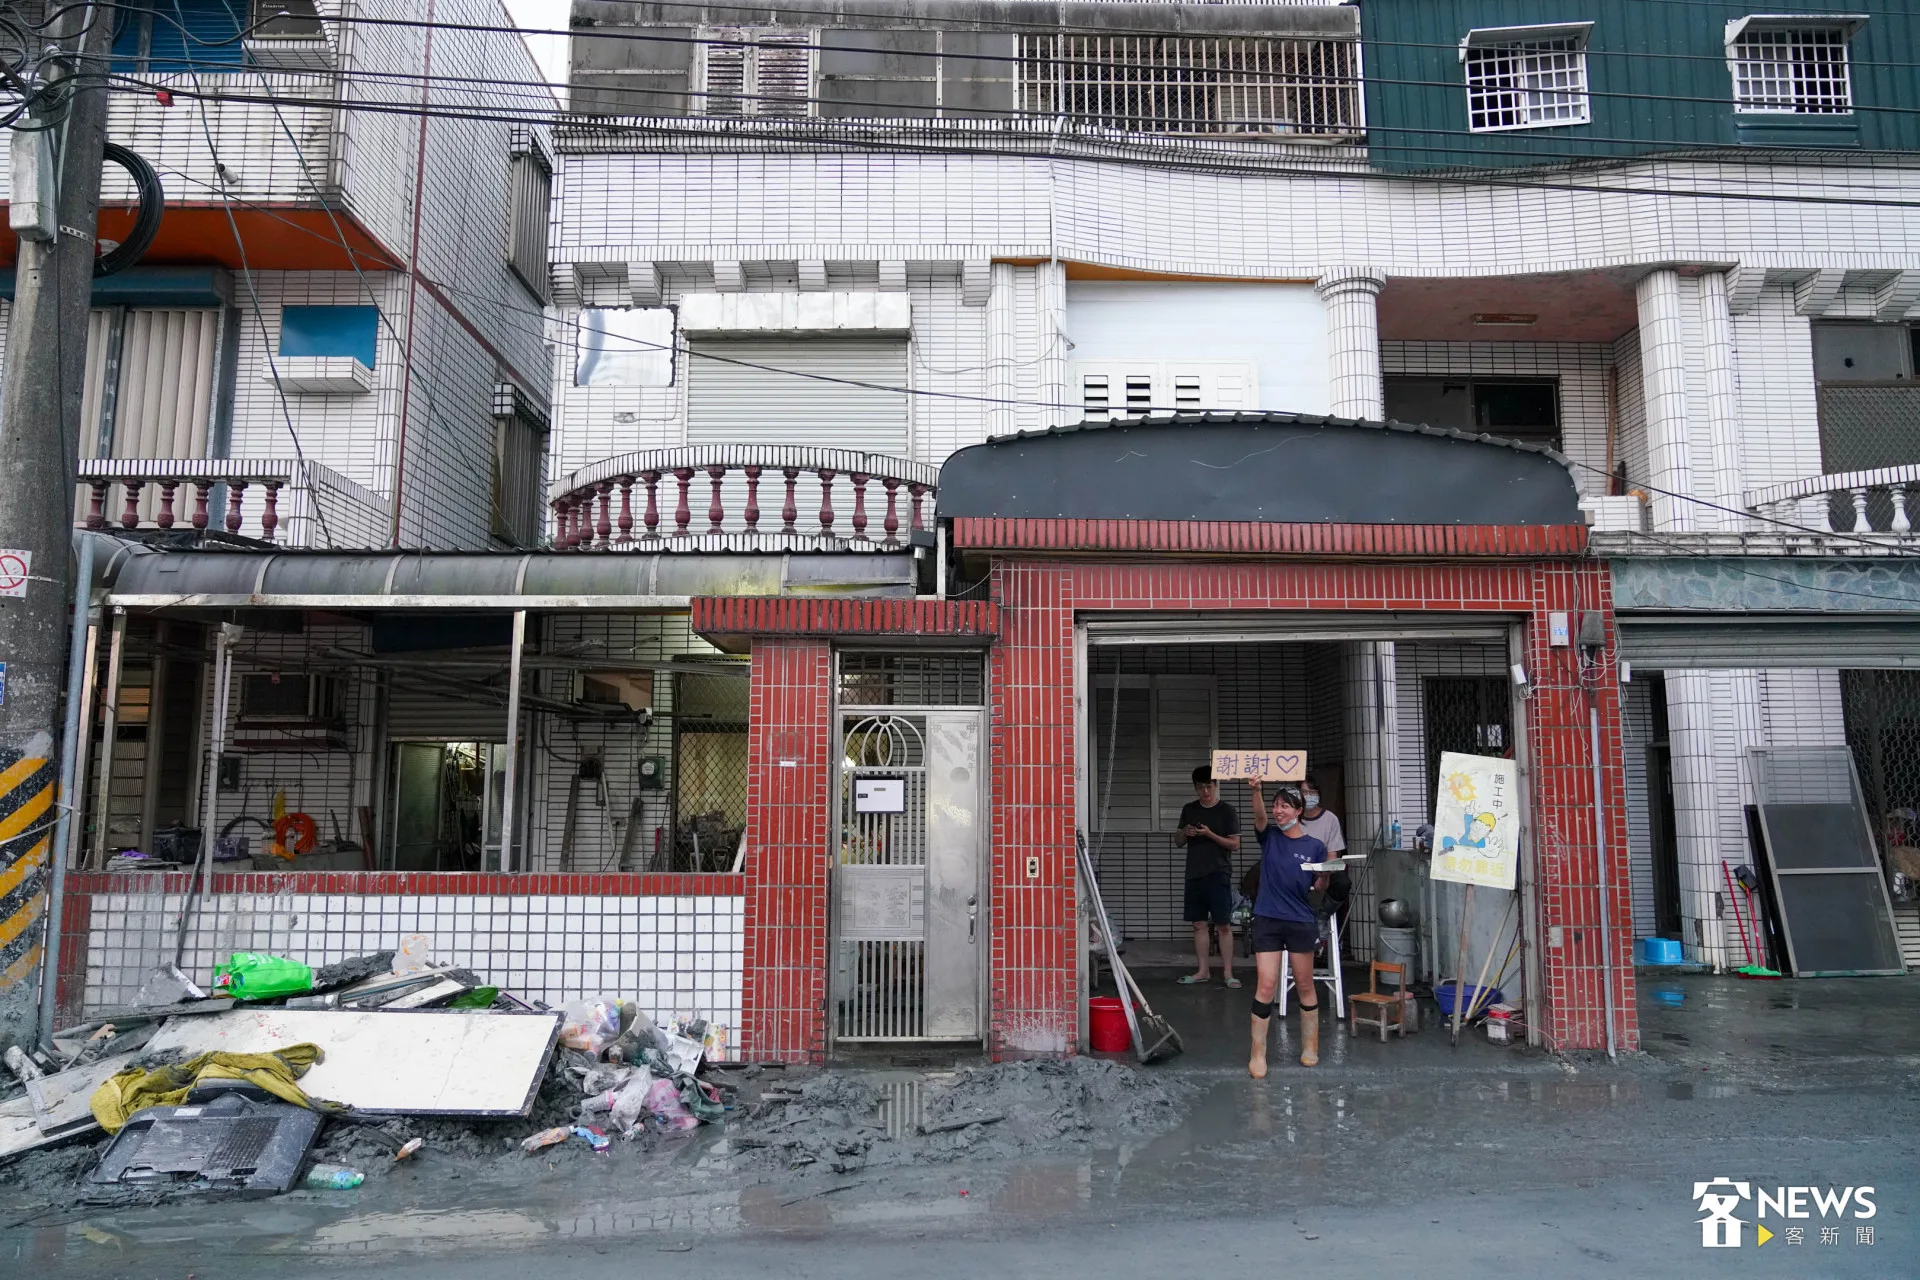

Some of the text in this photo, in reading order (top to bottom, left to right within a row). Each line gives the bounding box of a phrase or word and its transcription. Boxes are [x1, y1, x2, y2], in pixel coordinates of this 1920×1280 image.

[1216, 754, 1270, 775] 謝謝
[1493, 773, 1505, 809] 施工中
